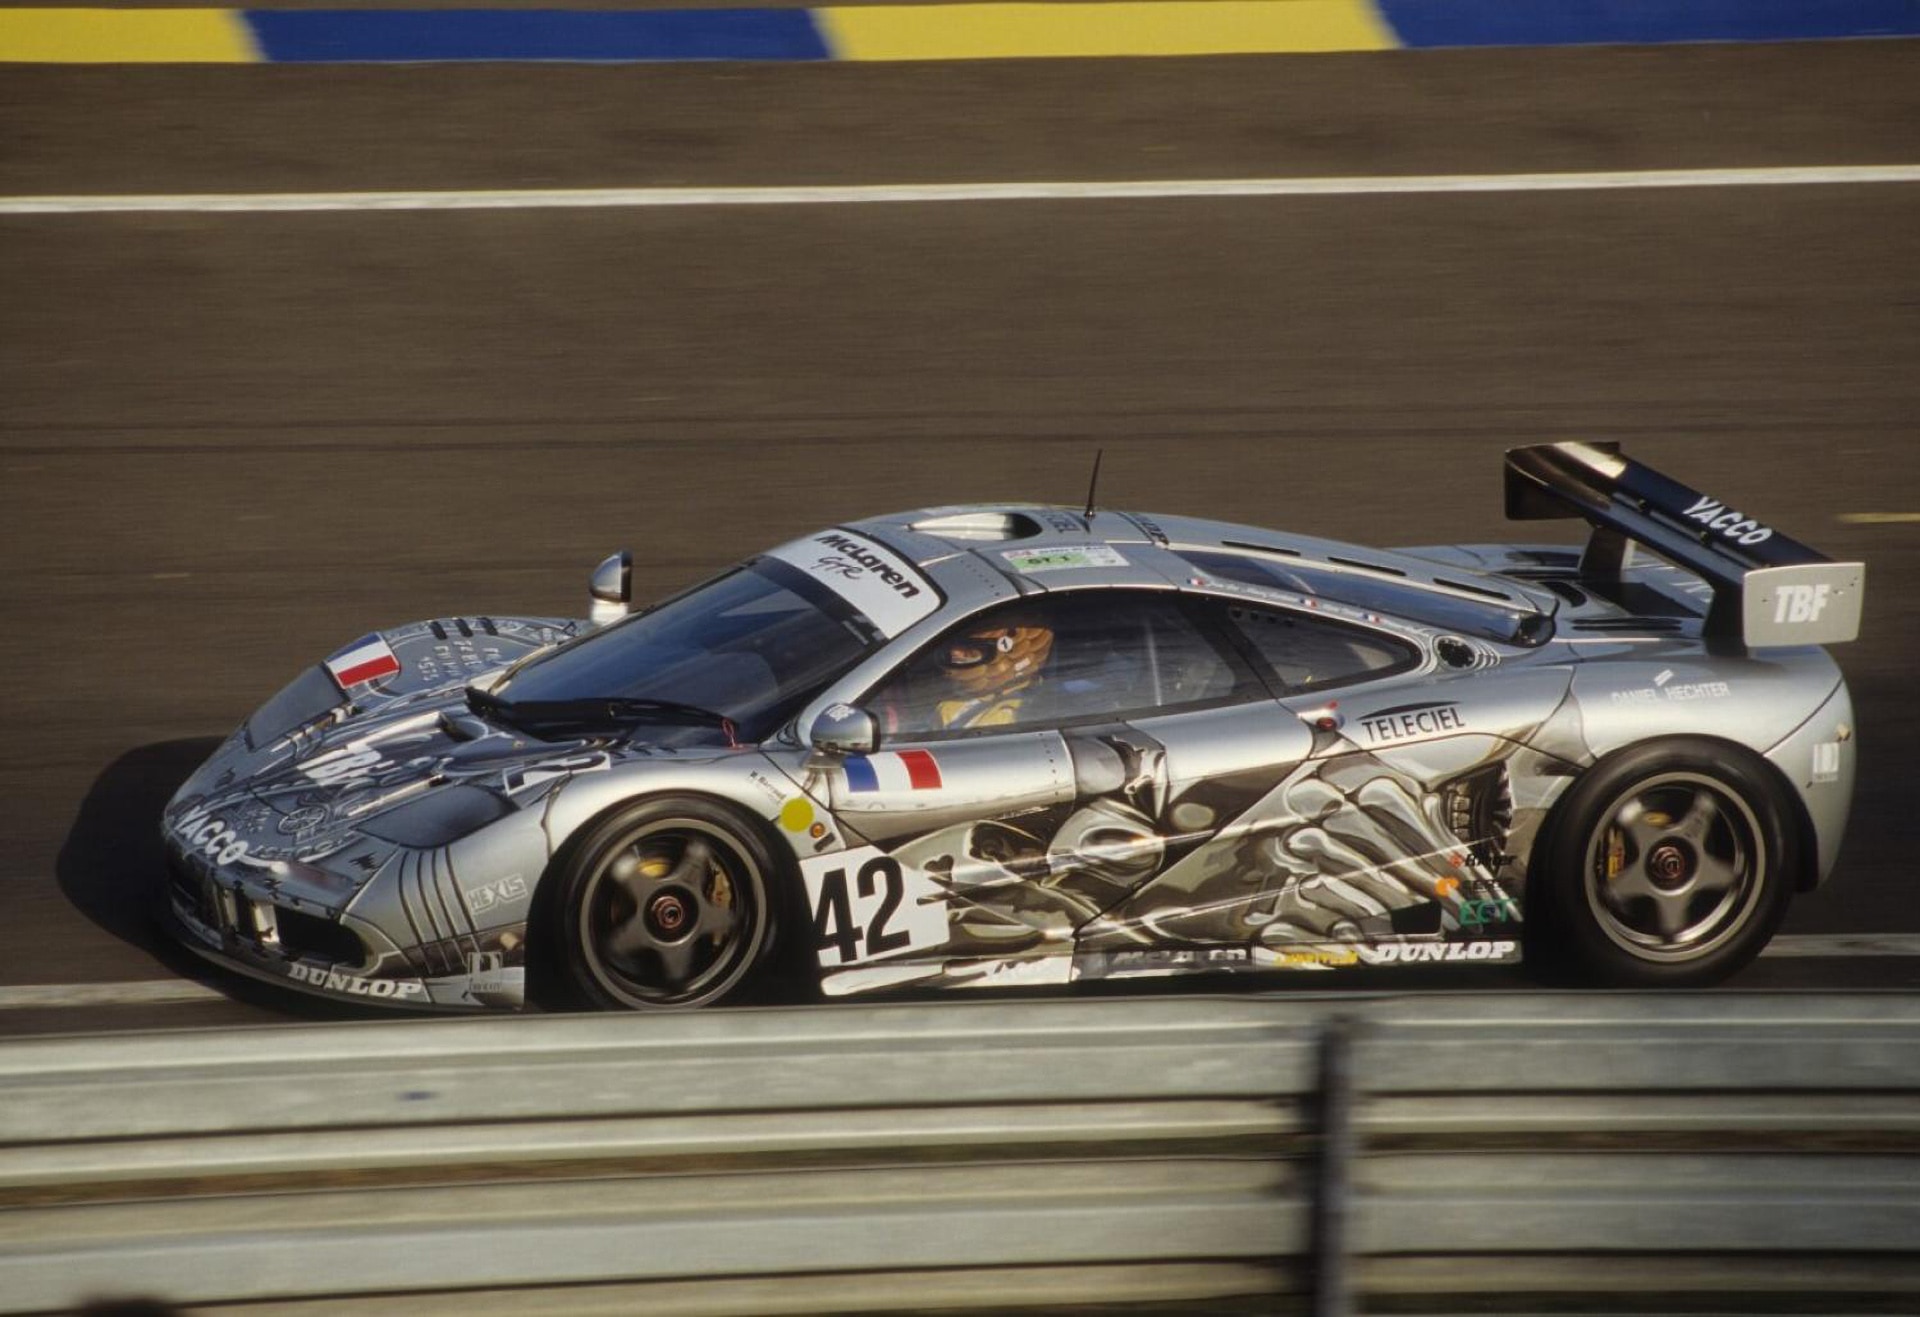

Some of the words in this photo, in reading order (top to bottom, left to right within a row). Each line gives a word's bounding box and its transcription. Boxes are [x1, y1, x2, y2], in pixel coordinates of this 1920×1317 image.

[1682, 496, 1772, 546] YACCO
[813, 534, 922, 599] McLaren
[1773, 584, 1831, 624] TBF
[1664, 681, 1731, 700] HECHTER
[1362, 706, 1466, 743] TELECIEL
[174, 804, 249, 866] YACCO
[467, 876, 528, 914] HEXIS
[812, 855, 911, 963] 42
[1376, 941, 1516, 964] DUNLOP
[287, 961, 423, 999] DUNLOP
